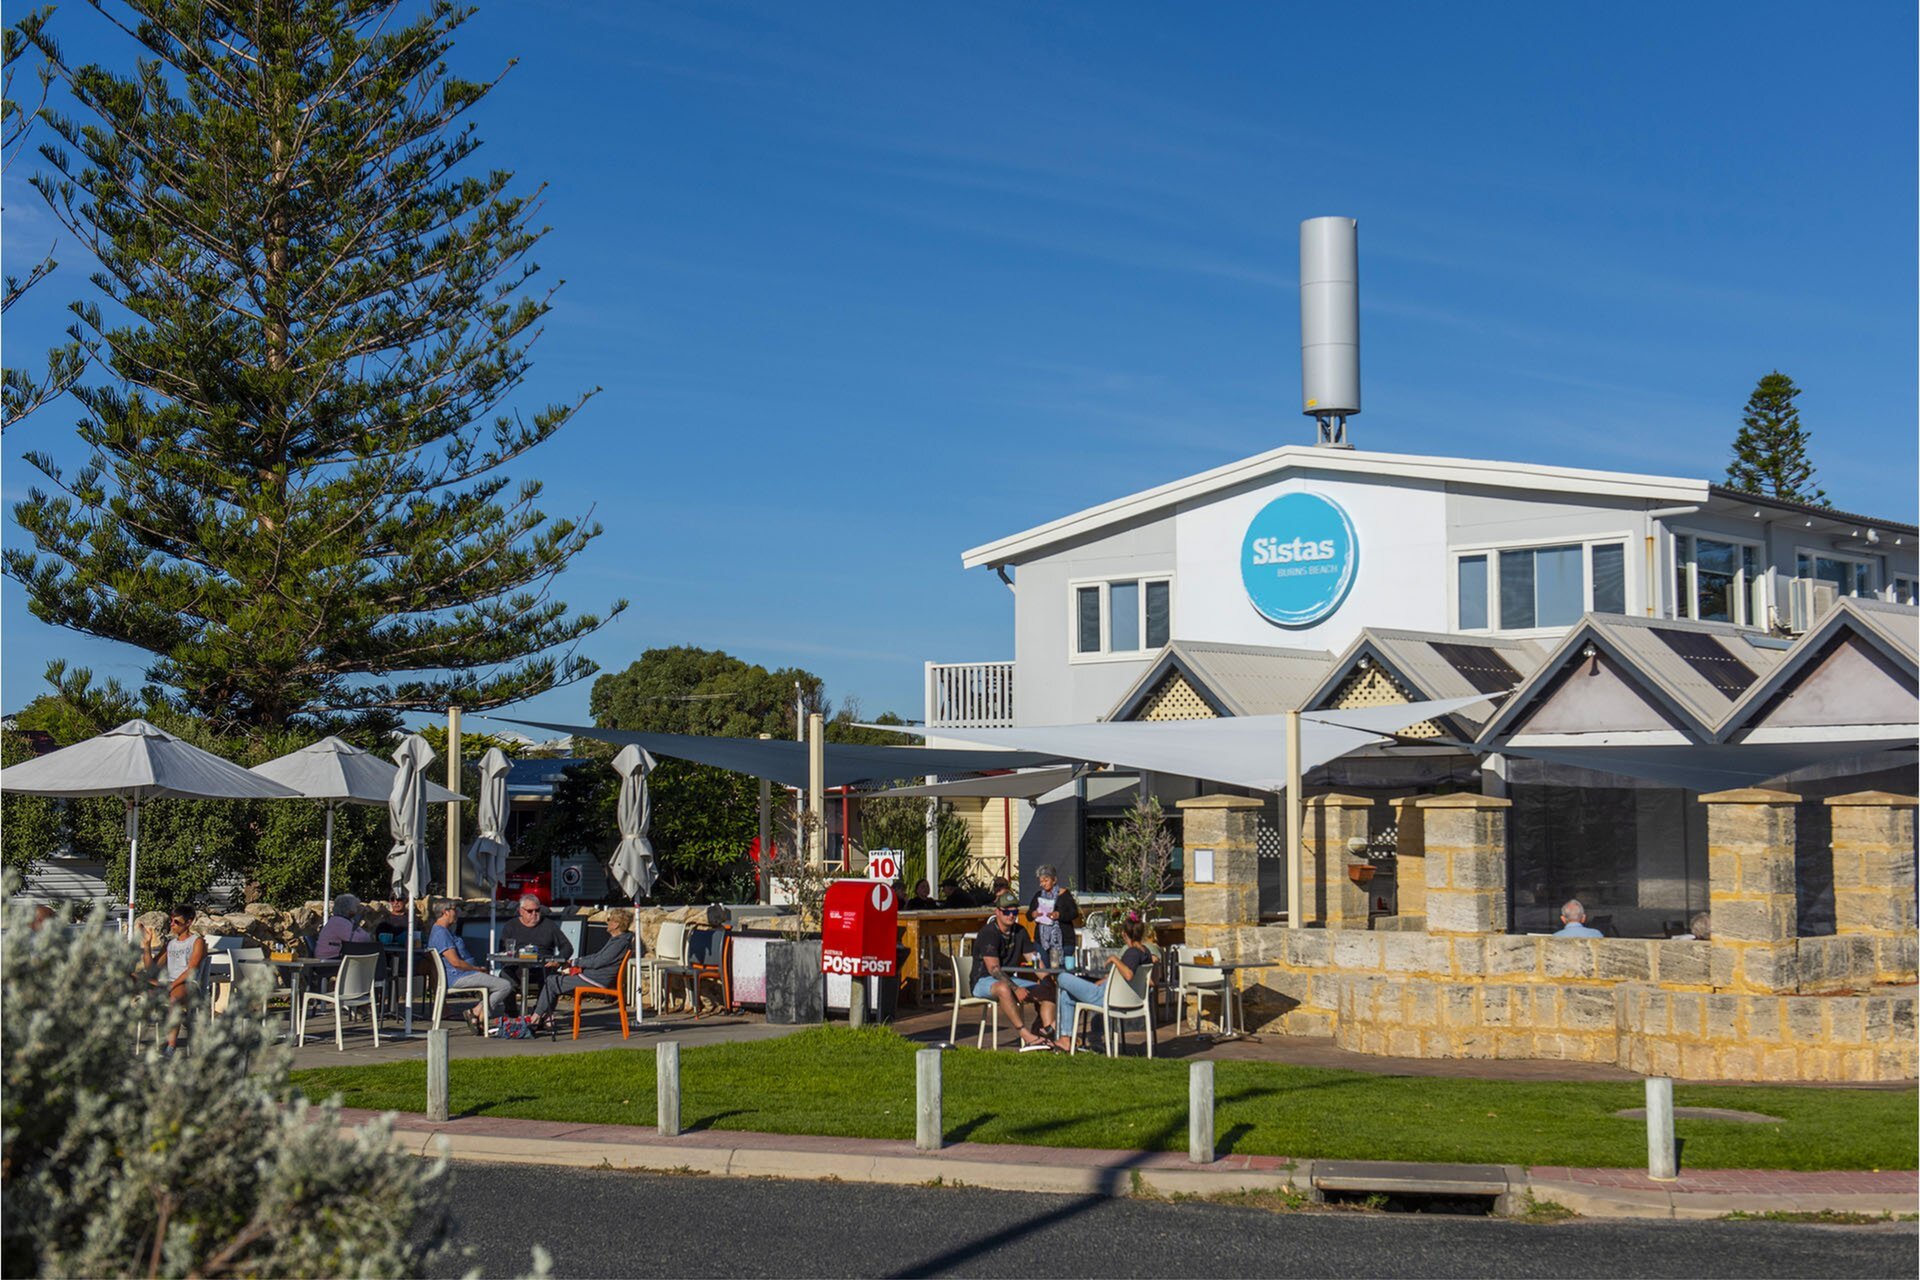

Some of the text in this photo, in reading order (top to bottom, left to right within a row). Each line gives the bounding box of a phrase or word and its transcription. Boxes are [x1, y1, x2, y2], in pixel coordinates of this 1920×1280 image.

[1252, 536, 1335, 565] Sistas
[1277, 564, 1338, 577] BURNS BEACH
[870, 858, 895, 878] 10
[823, 955, 861, 974] POST
[861, 960, 892, 973] POST
